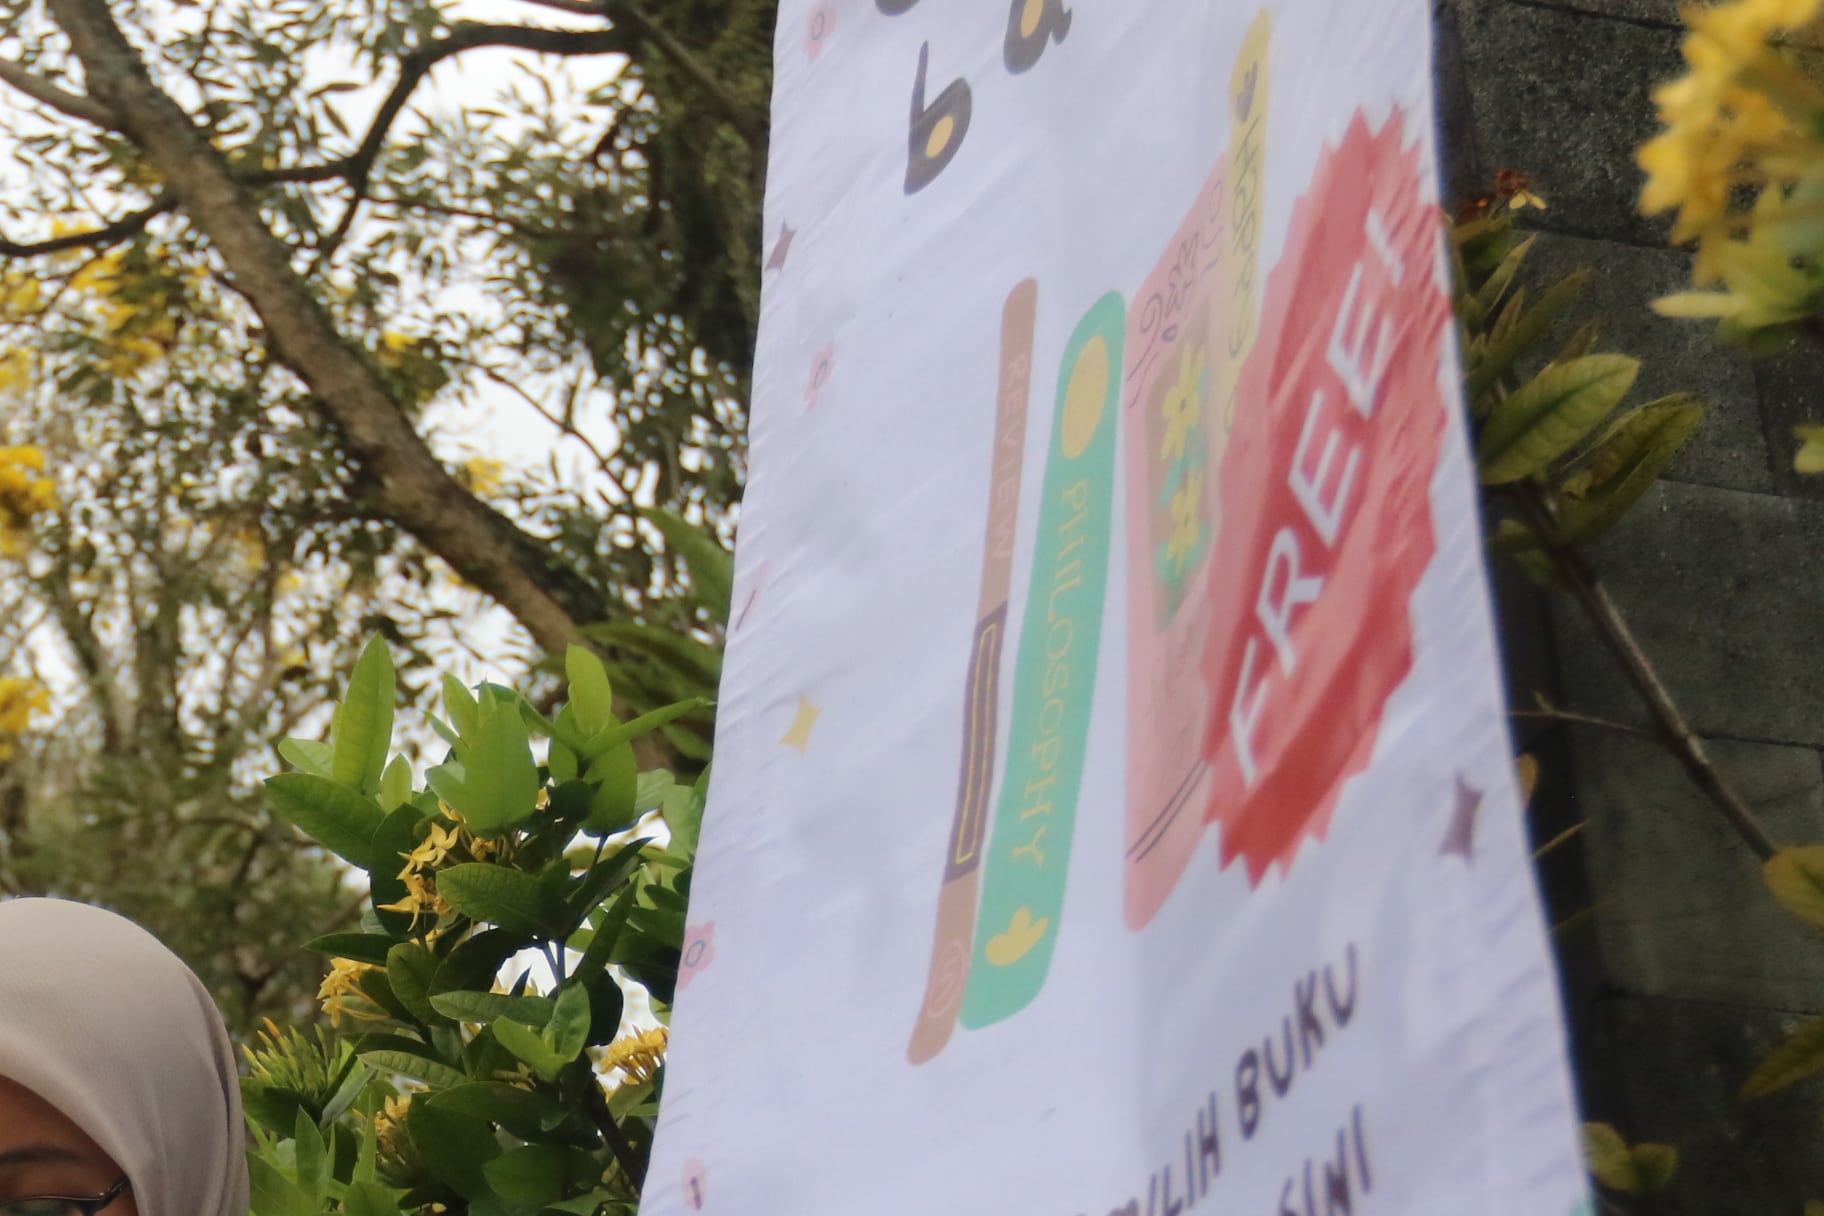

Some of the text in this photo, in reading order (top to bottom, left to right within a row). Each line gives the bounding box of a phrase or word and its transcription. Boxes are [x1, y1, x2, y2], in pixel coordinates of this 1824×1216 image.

[992, 352, 1028, 560] REVIEW
[1012, 479, 1089, 869] PHILOSOPHY
[1234, 941, 1357, 1141] BUKU
